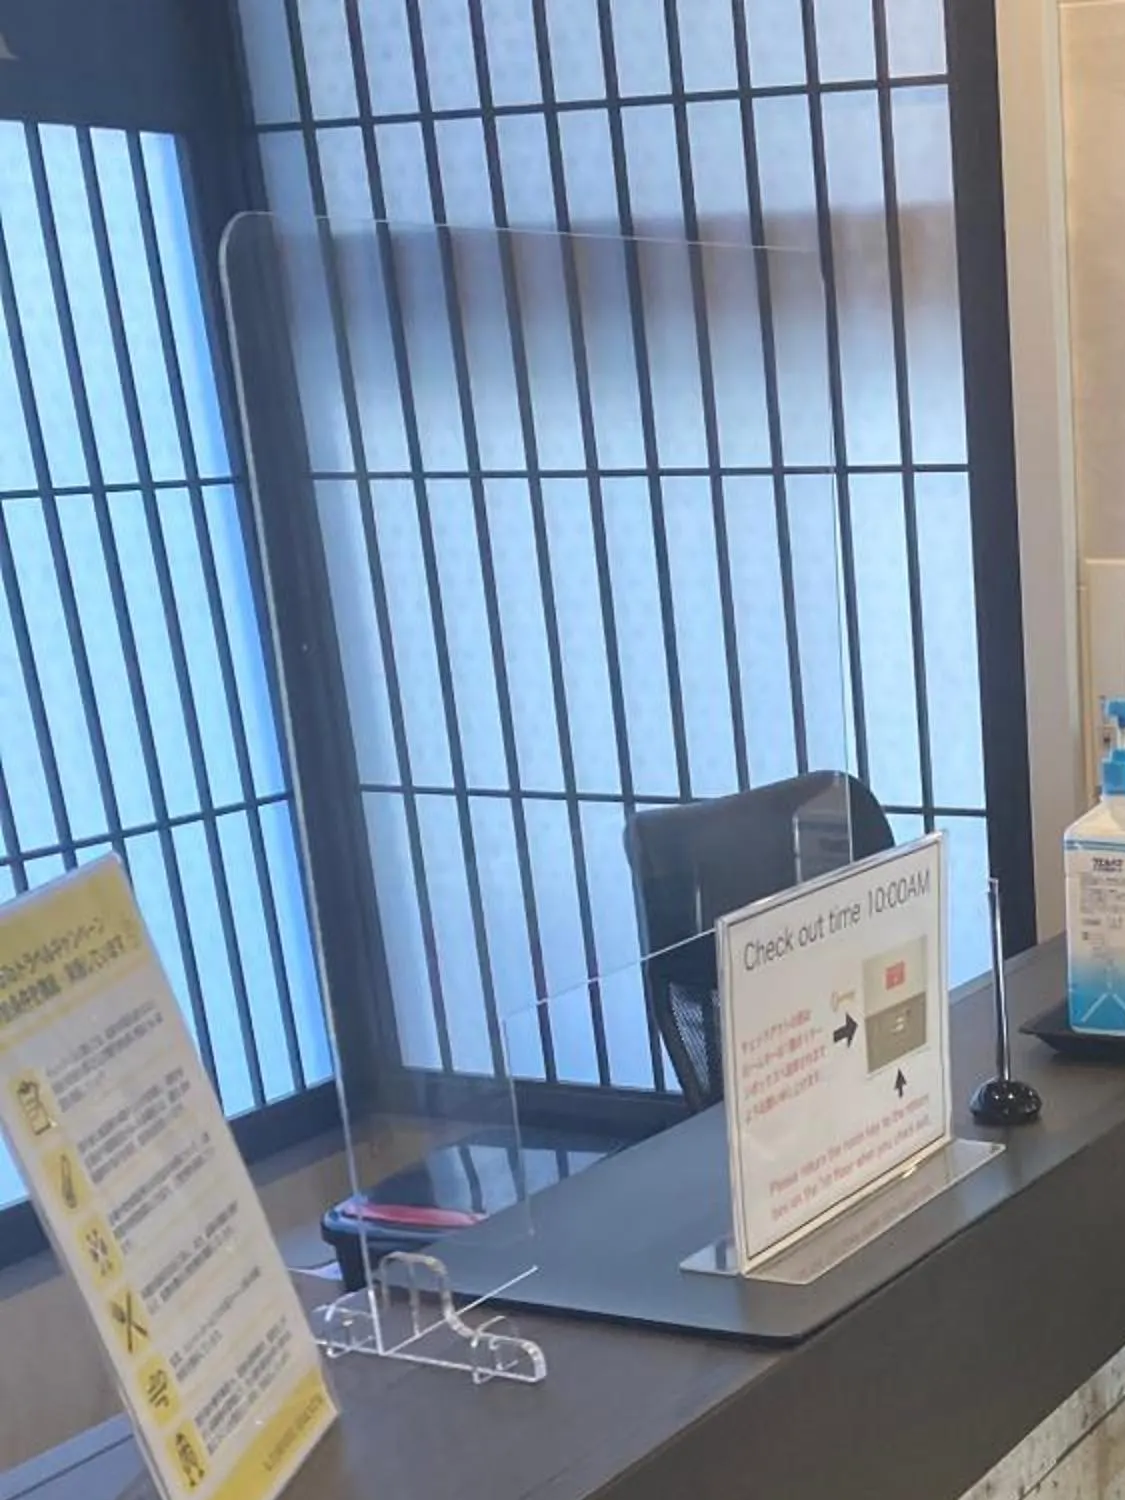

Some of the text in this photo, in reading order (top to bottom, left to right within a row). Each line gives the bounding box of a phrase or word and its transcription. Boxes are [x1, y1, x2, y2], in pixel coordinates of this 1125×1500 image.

[743, 926, 794, 971] Check
[798, 914, 825, 947] out
[828, 903, 861, 934] time
